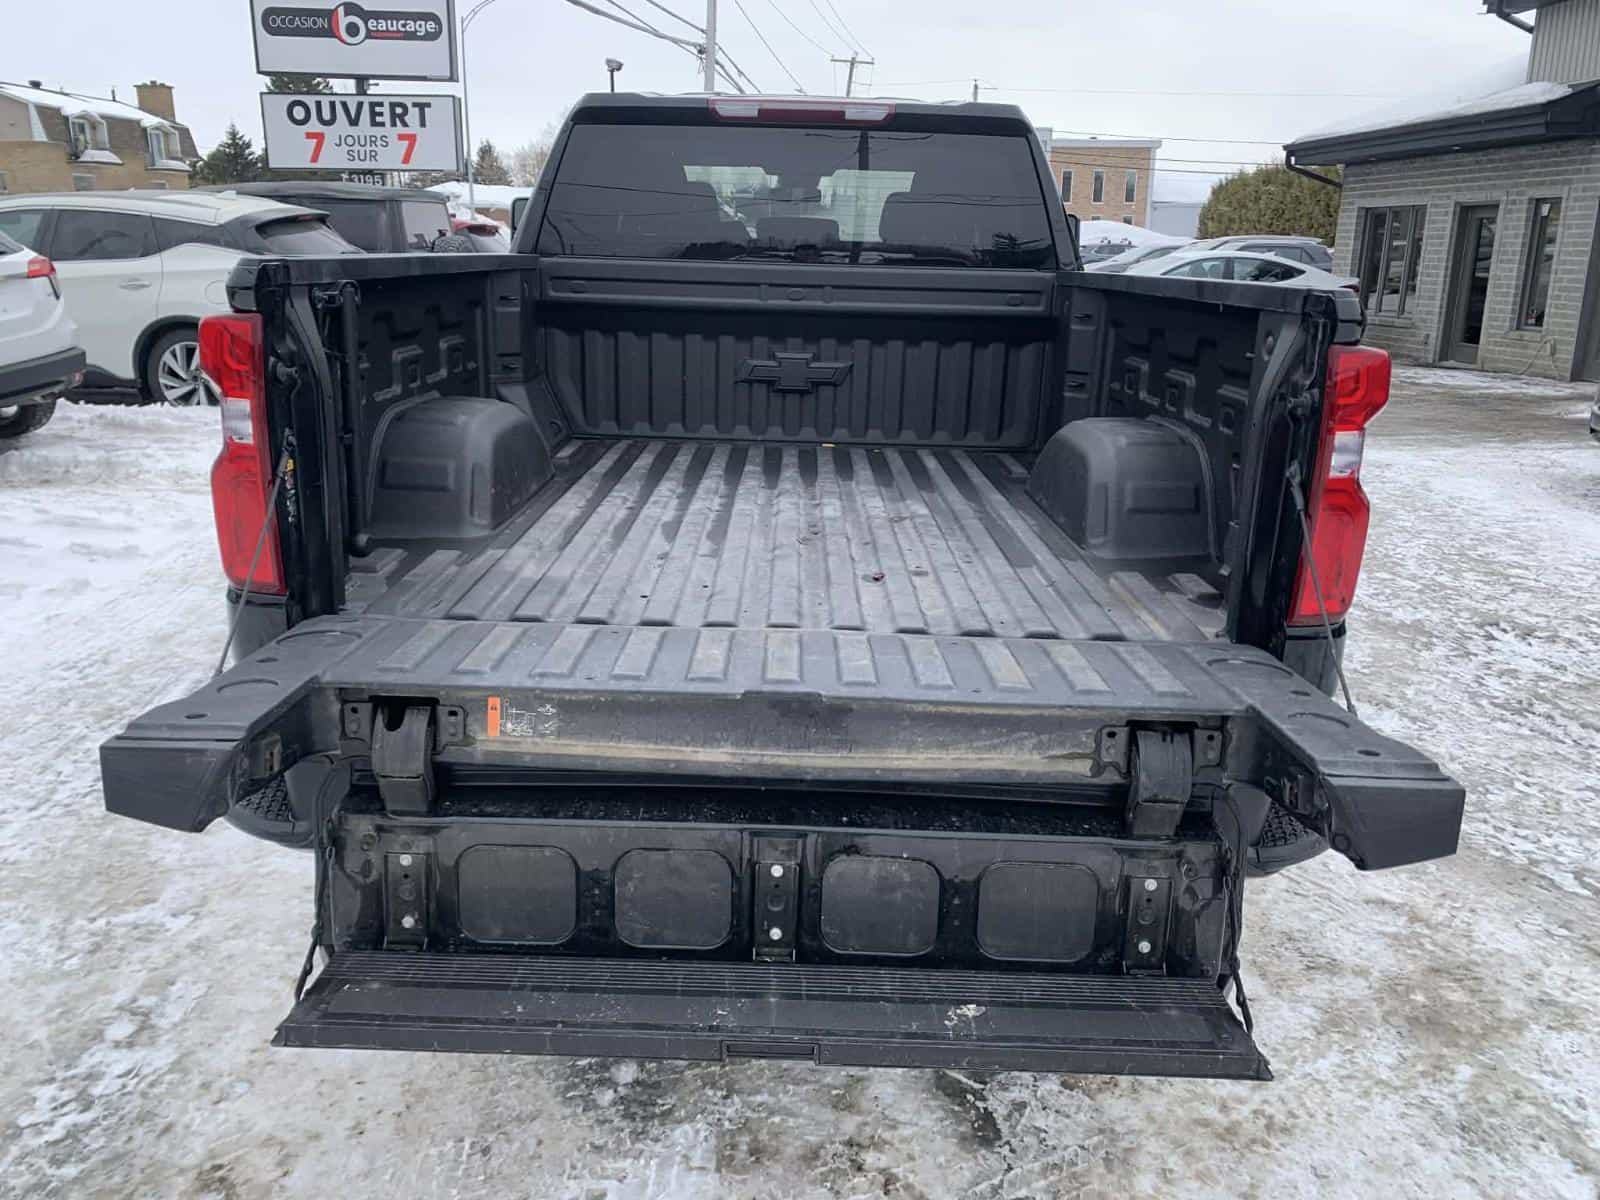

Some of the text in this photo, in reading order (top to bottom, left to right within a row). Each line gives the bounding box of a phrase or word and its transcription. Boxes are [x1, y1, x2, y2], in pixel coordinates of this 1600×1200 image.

[269, 15, 328, 29] OCCASION
[286, 99, 432, 128] OUVERT
[304, 131, 418, 165] 7 JOURS 7
[346, 149, 379, 162] SUR
